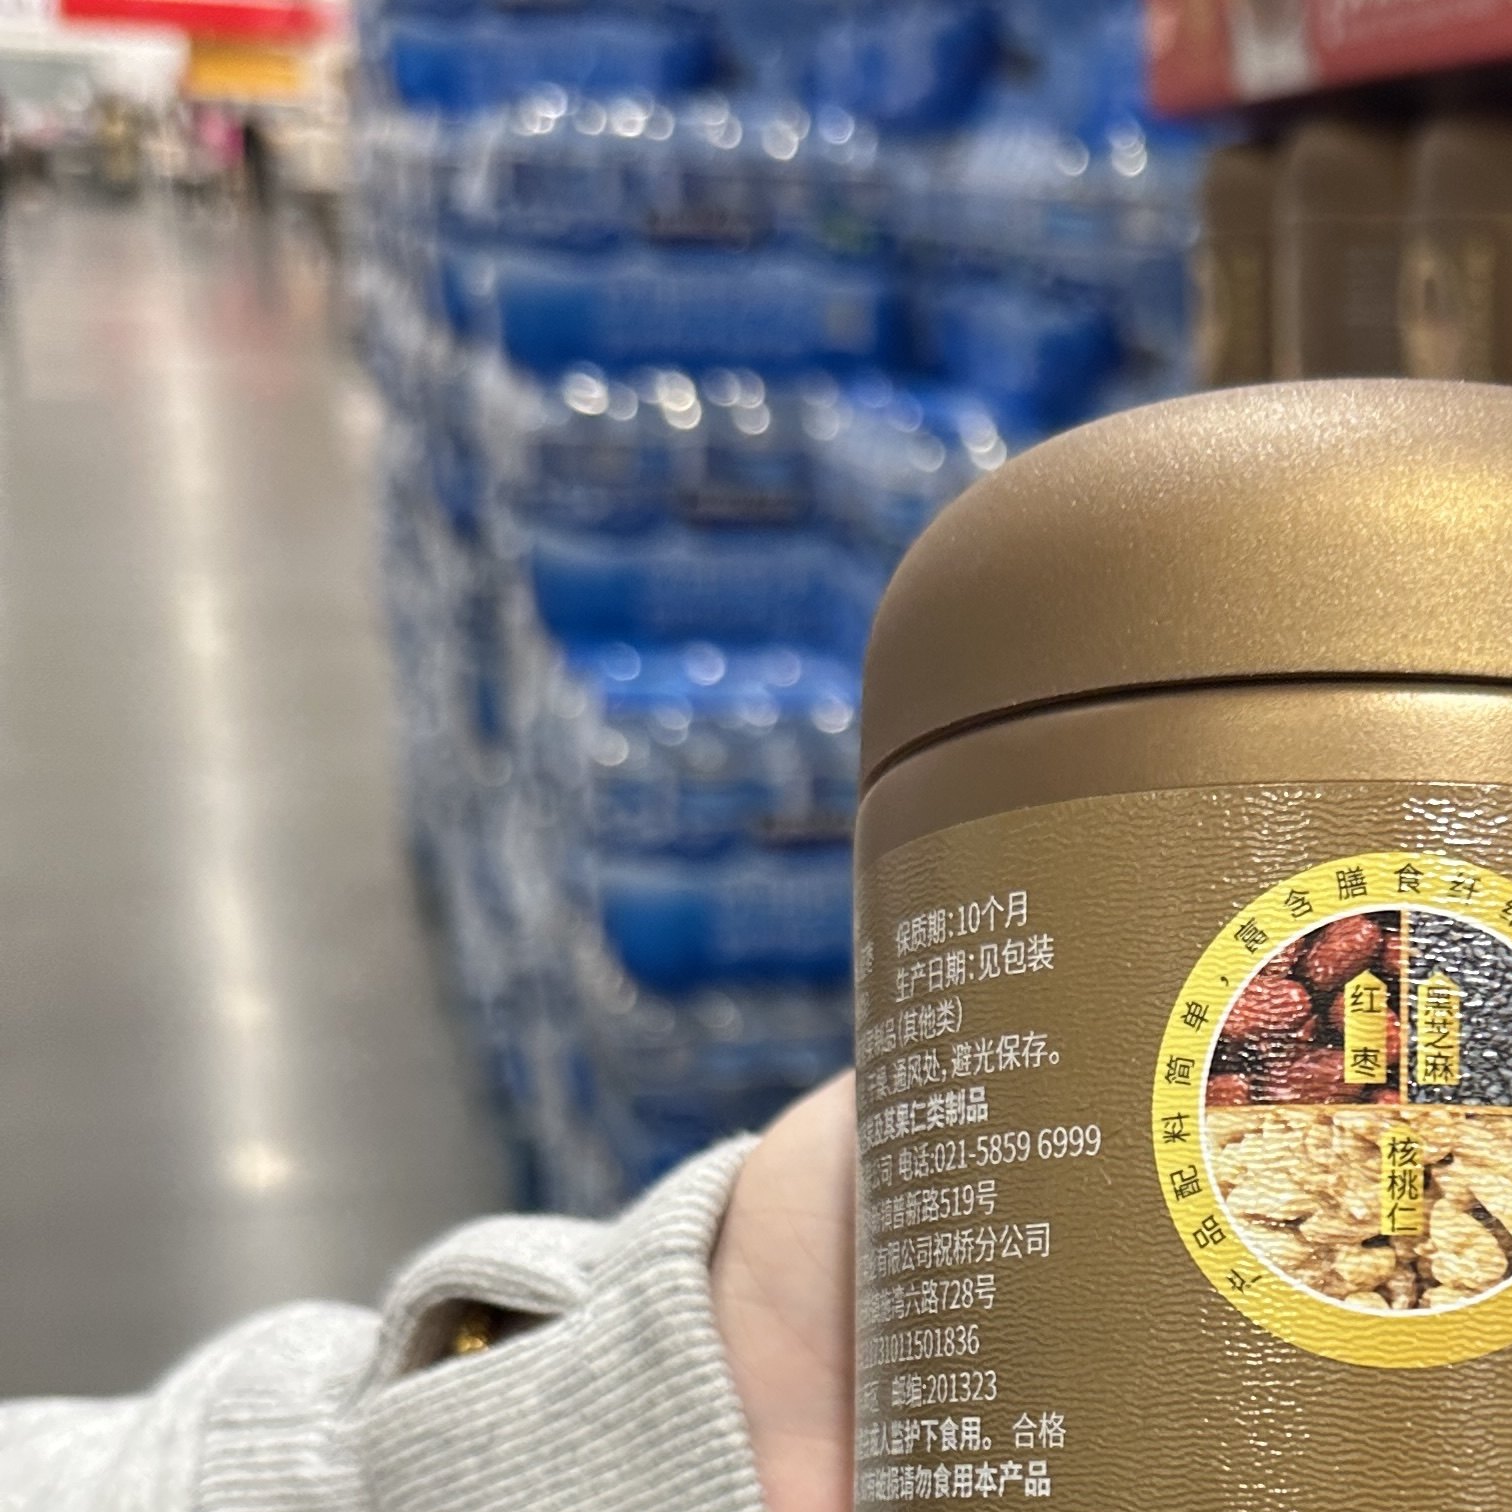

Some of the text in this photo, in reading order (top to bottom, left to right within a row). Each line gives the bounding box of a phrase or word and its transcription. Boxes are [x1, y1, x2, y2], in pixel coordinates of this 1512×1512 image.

[896, 890, 1028, 956] 保质期:10个月
[895, 933, 1055, 1003] 生产日期:见包装
[1351, 984, 1382, 1080] 红枣
[1423, 985, 1455, 1082] 黑芝麻
[1037, 1124, 1101, 1159] 6999
[1386, 1136, 1420, 1233] 核桃仁
[1012, 1411, 1067, 1449] 合格
